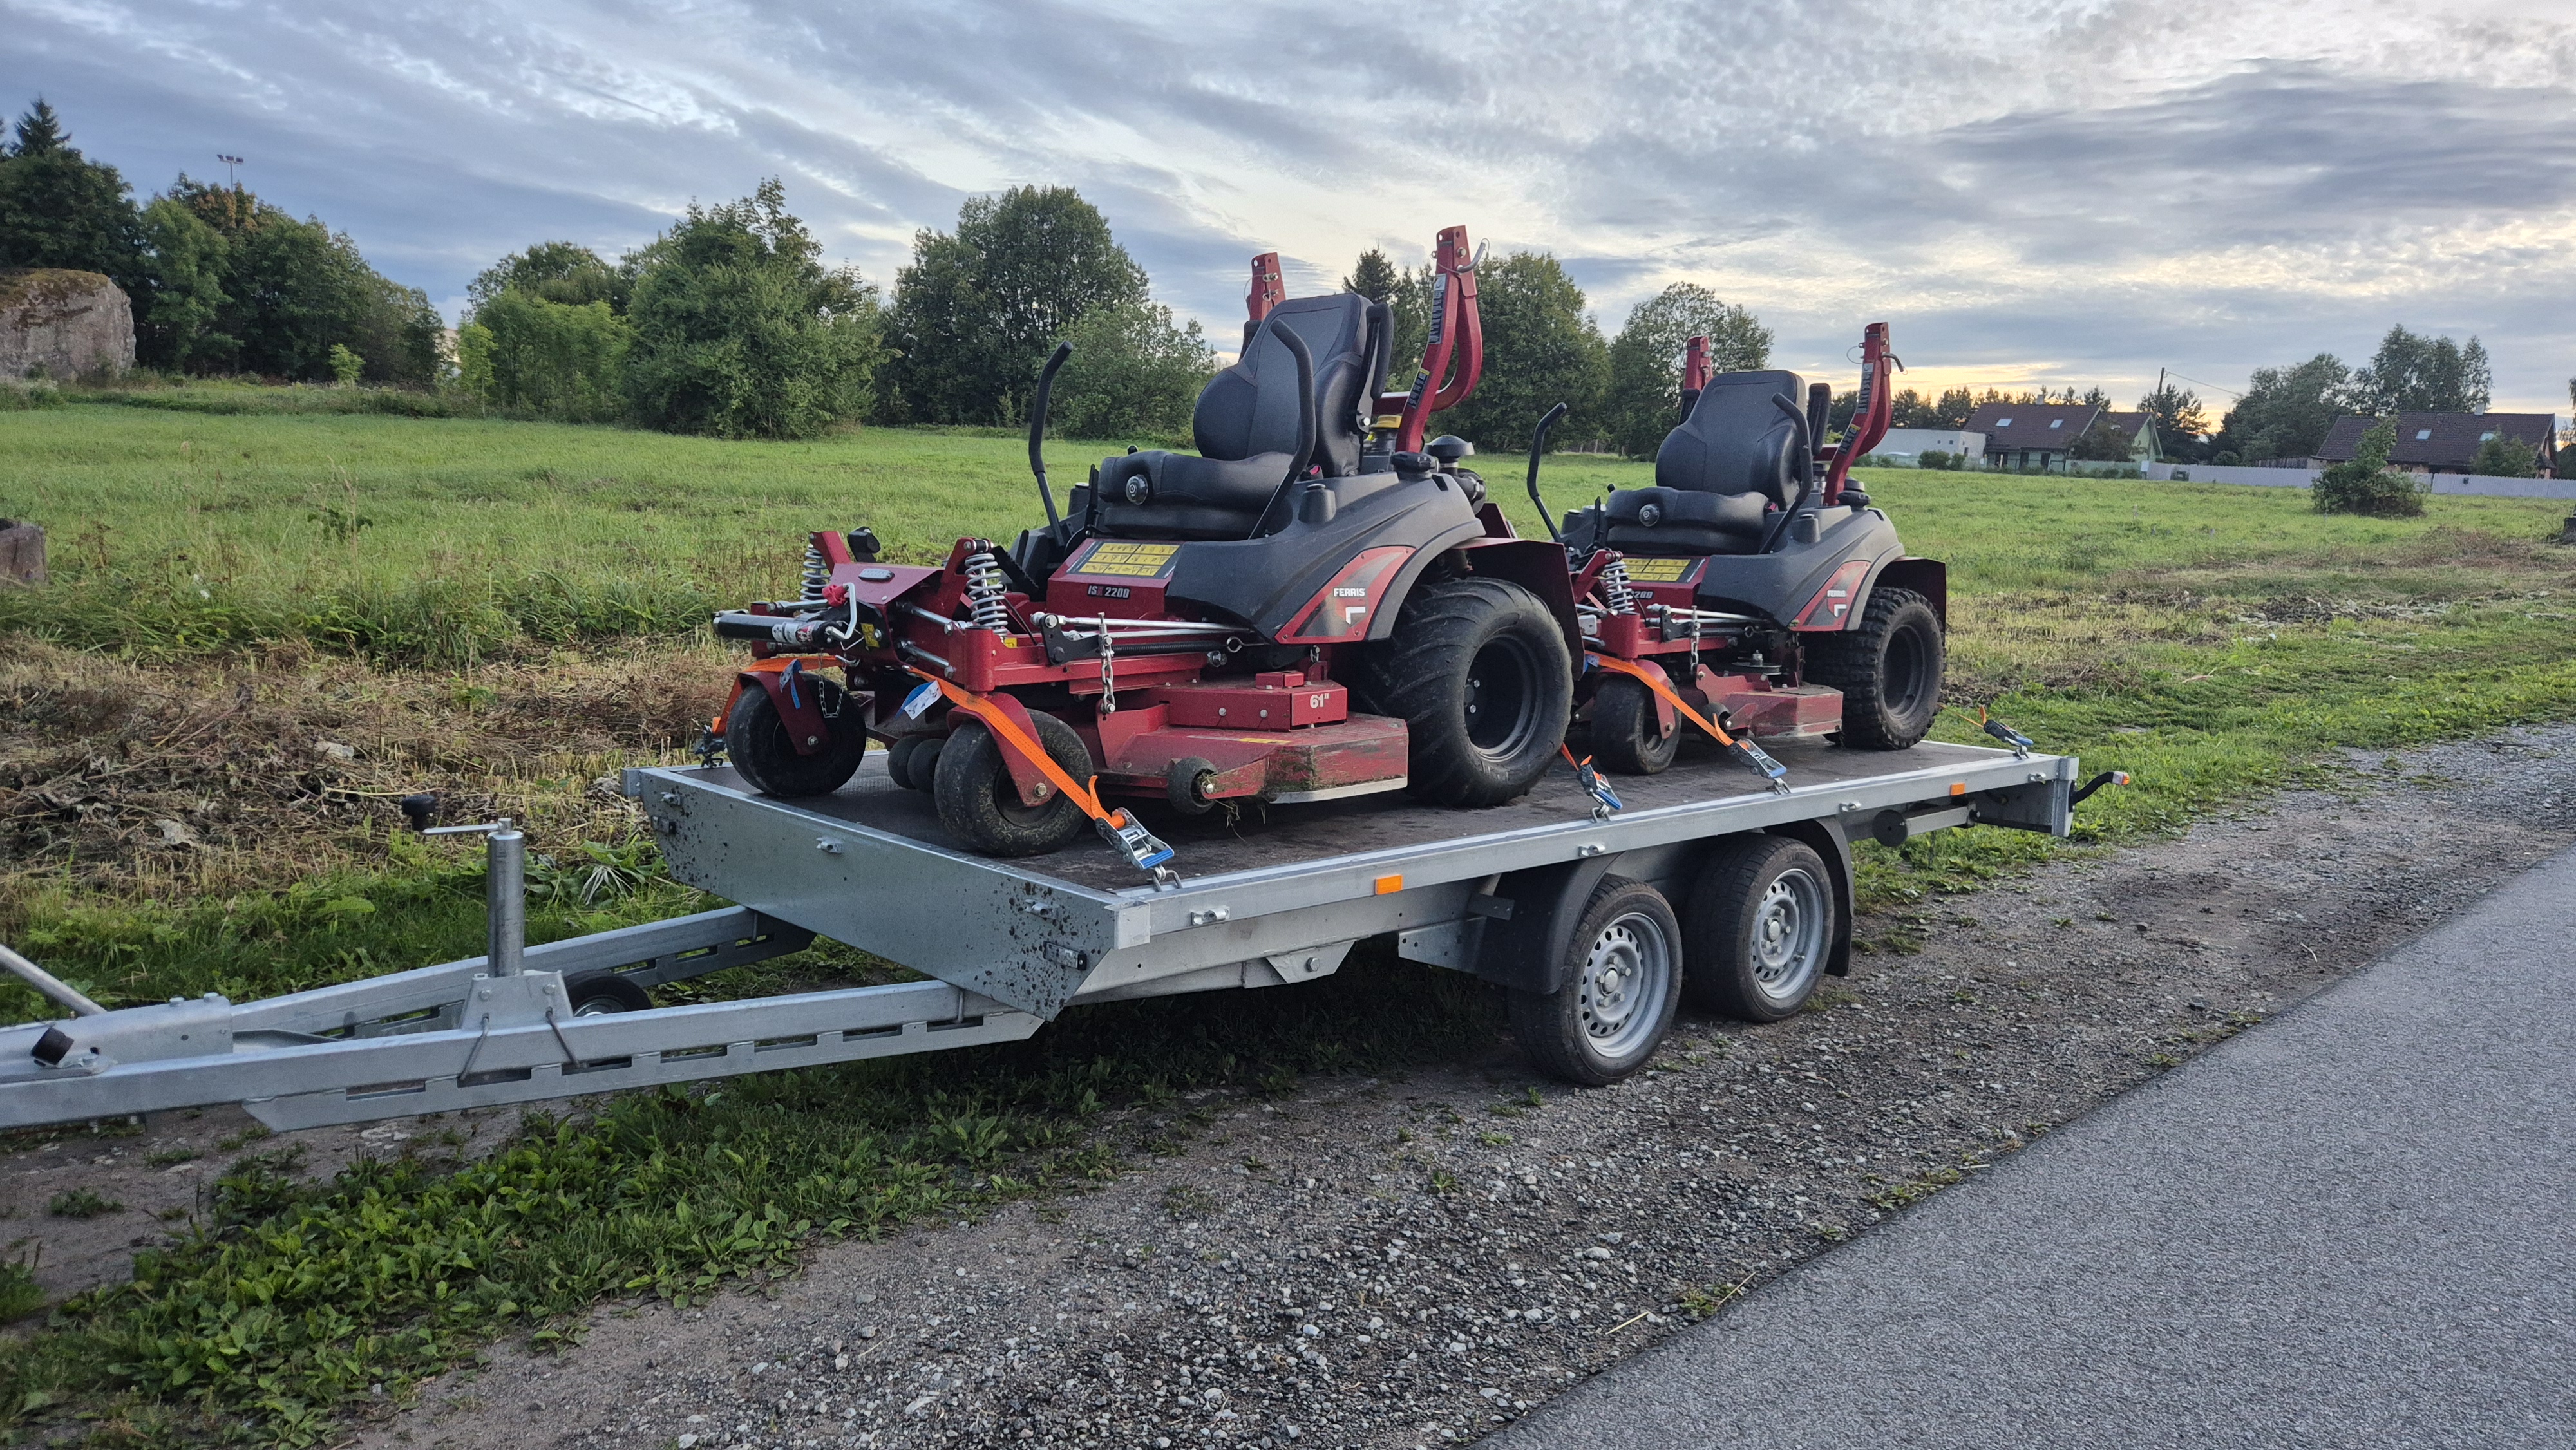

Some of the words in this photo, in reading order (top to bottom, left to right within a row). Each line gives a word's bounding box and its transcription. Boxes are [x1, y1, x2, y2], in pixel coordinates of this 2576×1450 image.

[1104, 587, 1130, 598] 2200
[1334, 588, 1365, 597] FERRIS
[1310, 693, 1330, 709] 61"
